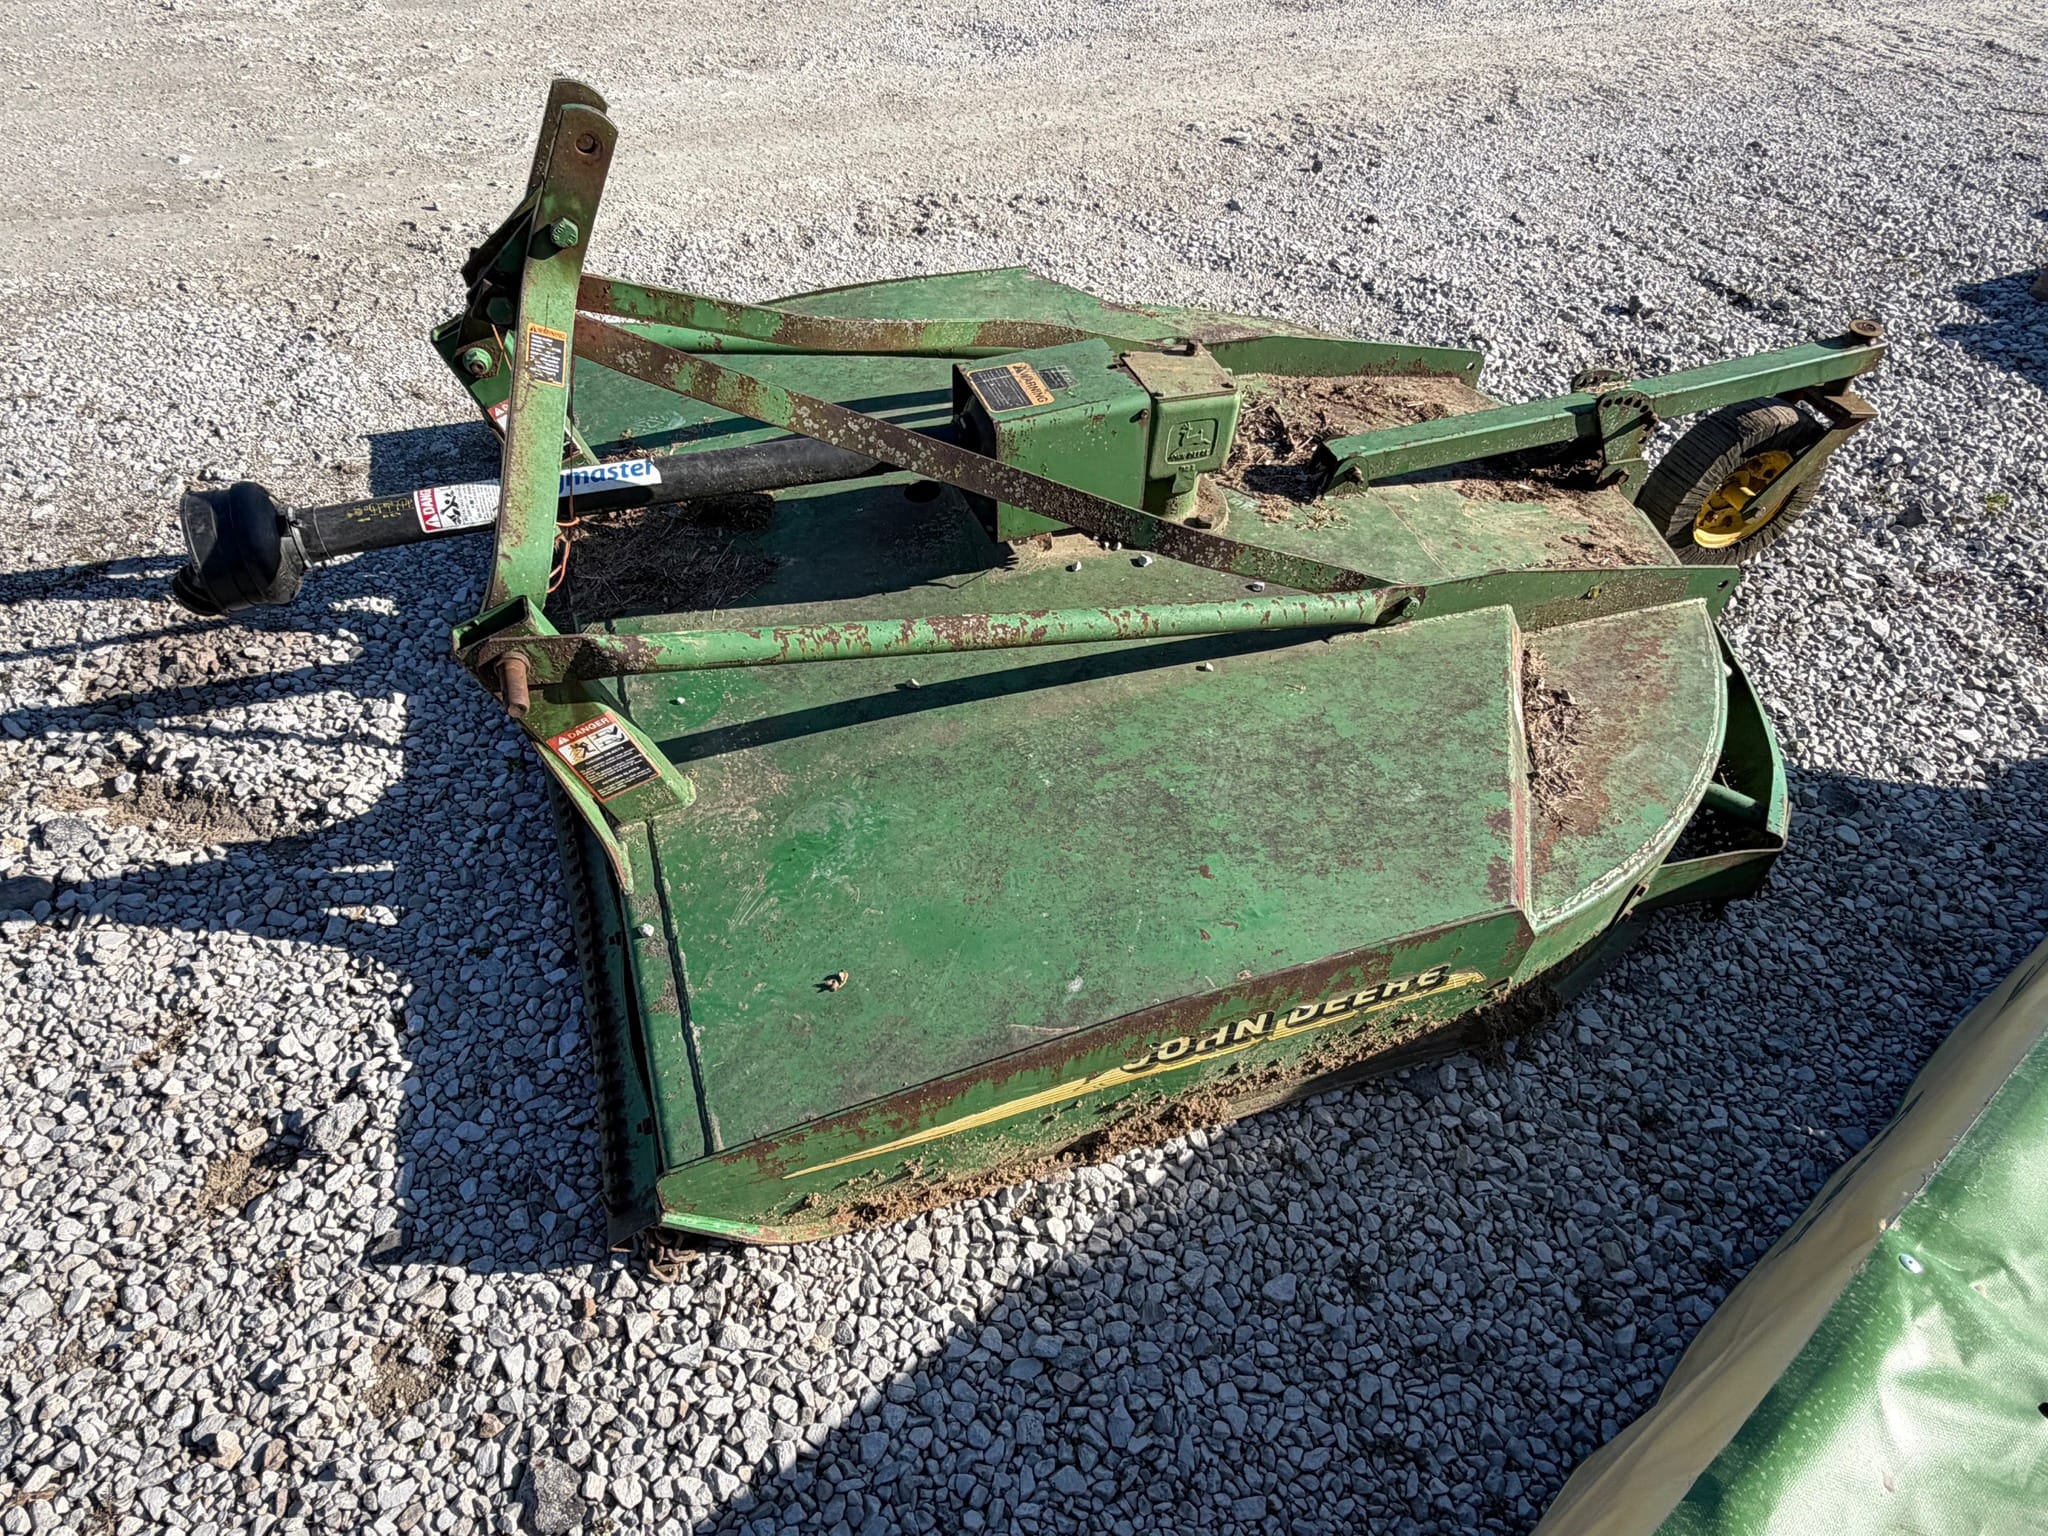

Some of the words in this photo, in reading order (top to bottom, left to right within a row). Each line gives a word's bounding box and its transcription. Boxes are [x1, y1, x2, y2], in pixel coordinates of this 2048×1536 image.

[1020, 370, 1049, 404] WARNING
[567, 716, 610, 740] DANGER
[1120, 1010, 1276, 1074] JOHN
[1285, 964, 1452, 1027] DEERE
